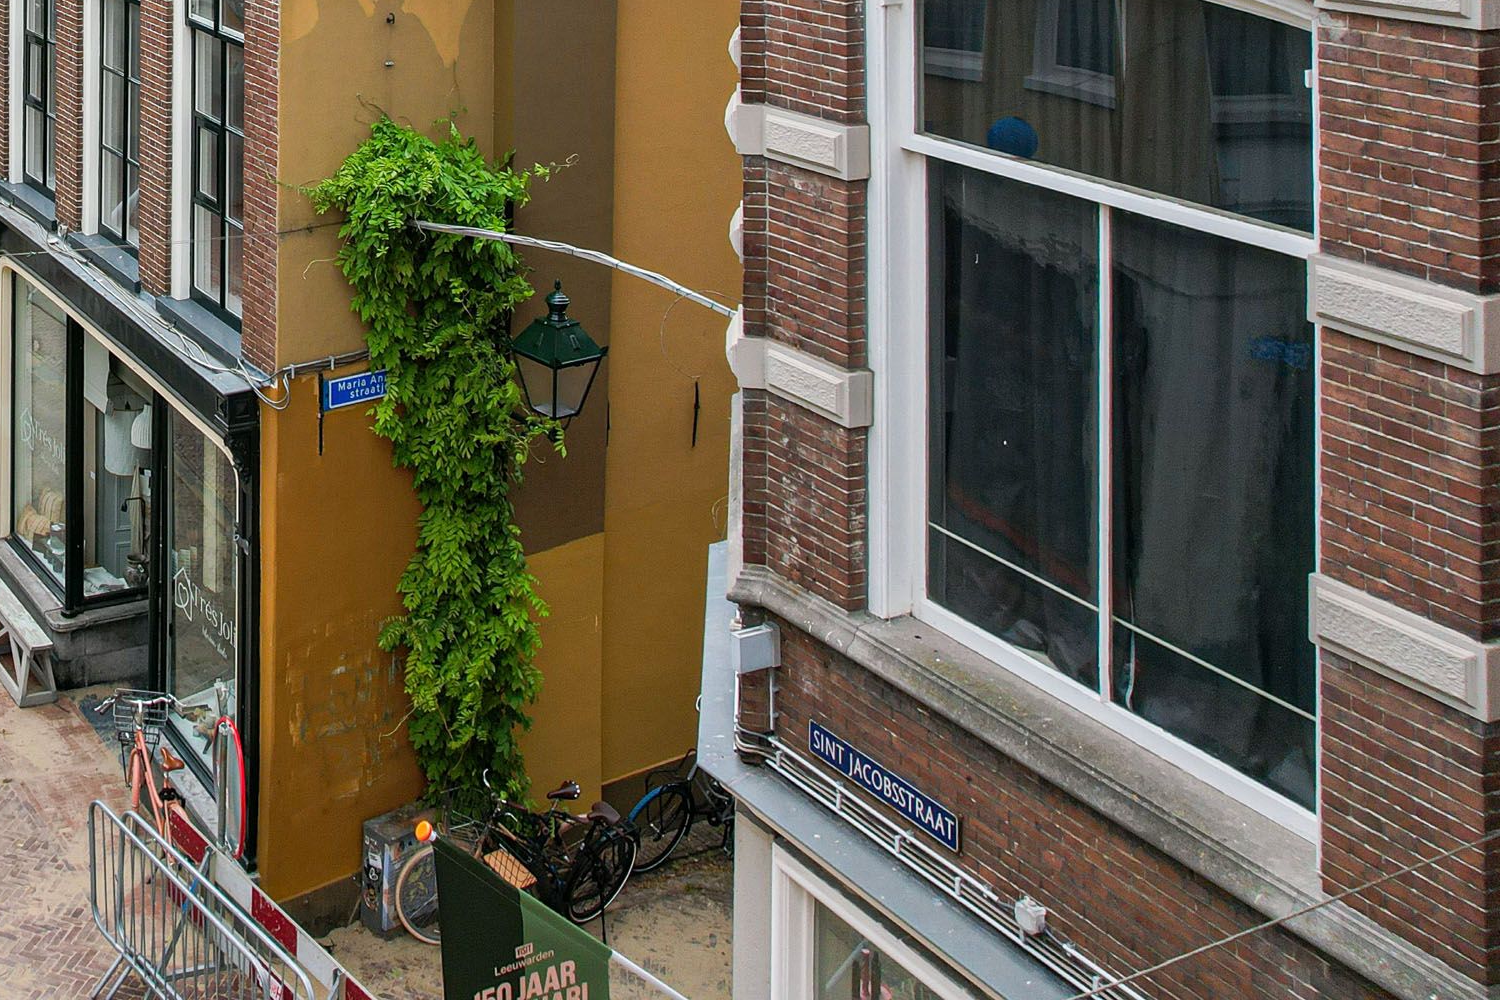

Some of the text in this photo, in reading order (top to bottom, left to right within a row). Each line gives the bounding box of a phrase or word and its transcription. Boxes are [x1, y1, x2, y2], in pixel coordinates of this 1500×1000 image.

[338, 379, 366, 392] Maria
[813, 730, 955, 840] SINT JACOBSSTRAAT
[494, 950, 555, 977] Leeuwarden
[516, 960, 576, 1000] JAAR
